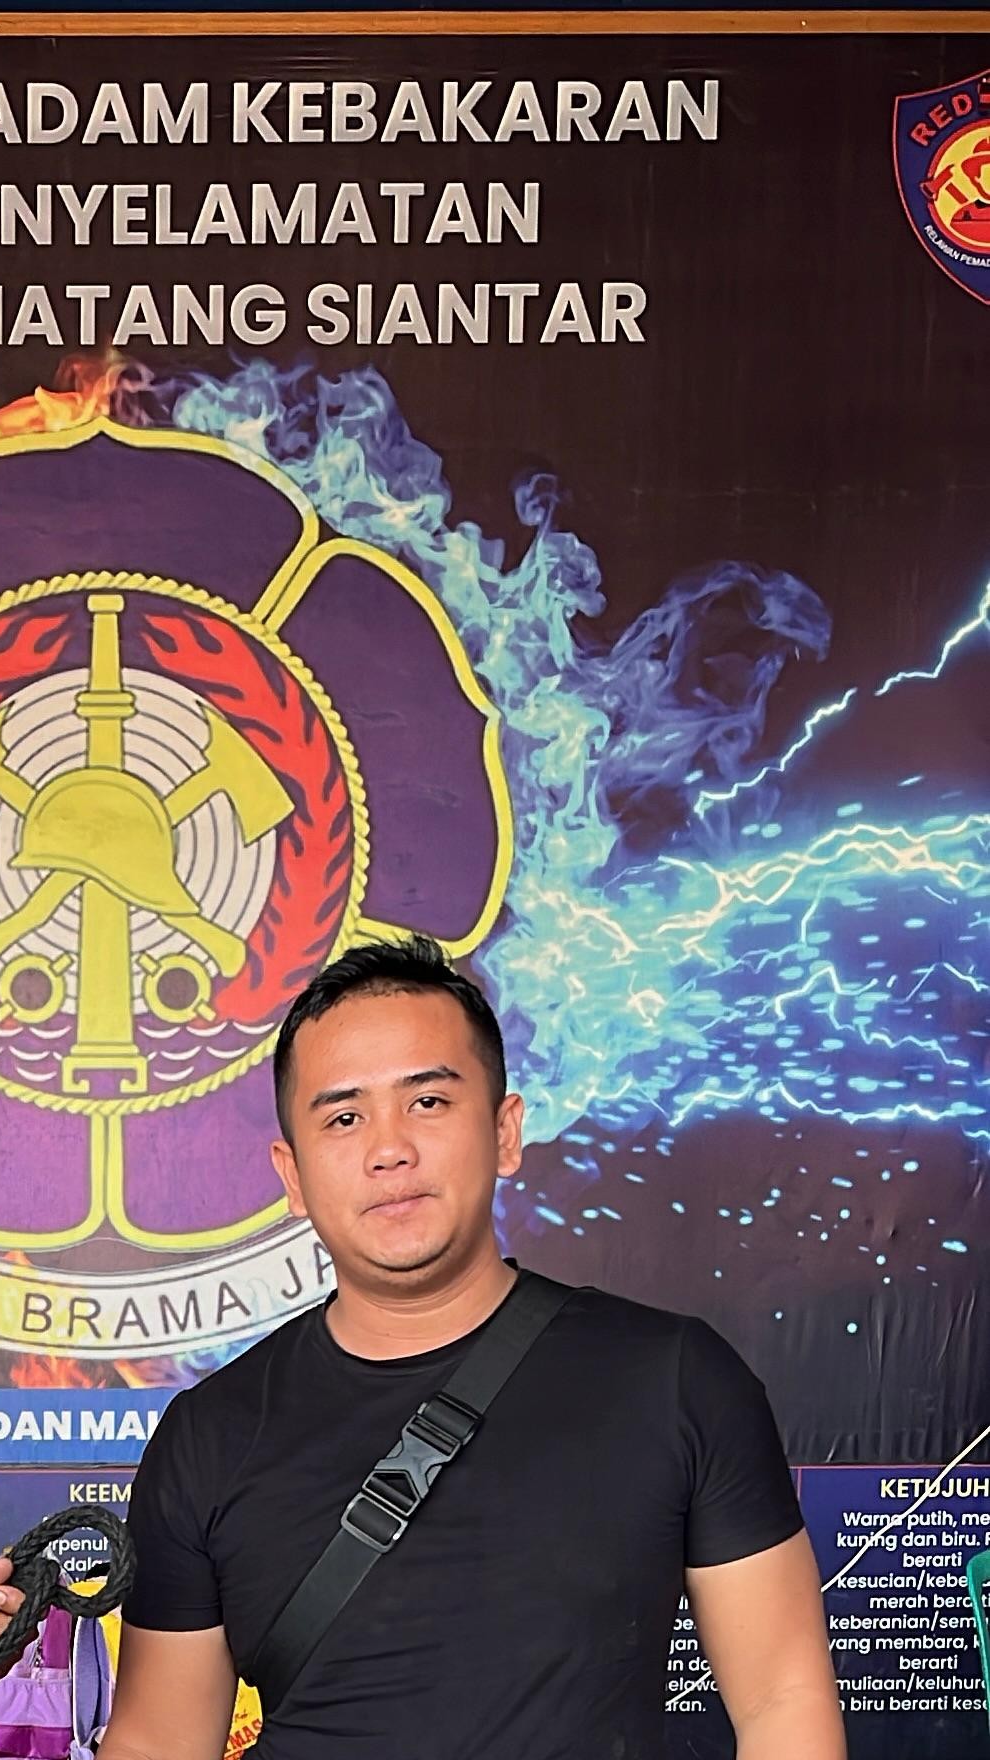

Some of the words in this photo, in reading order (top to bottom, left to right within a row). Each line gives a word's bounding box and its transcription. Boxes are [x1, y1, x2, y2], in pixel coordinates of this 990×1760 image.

[232, 79, 719, 144] KEBAKARAN
[910, 94, 972, 146] RED
[306, 282, 648, 345] SIANTAR
[22, 1281, 252, 1339] BRAMA
[880, 1478, 990, 1498] KETUJUH
[843, 1511, 903, 1527] Warna
[907, 1510, 958, 1530] putih,
[837, 1531, 898, 1551] kuning
[901, 1532, 937, 1547] dan
[941, 1531, 981, 1547] biru.
[903, 1552, 963, 1568] berarti
[837, 1570, 968, 1591] kesucian/kebe
[869, 1594, 929, 1609] merah
[829, 1610, 977, 1632] keberanian/sem
[875, 1635, 968, 1651] membara,
[899, 1654, 958, 1670] berarti
[850, 1696, 885, 1711] biru
[889, 1695, 948, 1711] berarti
